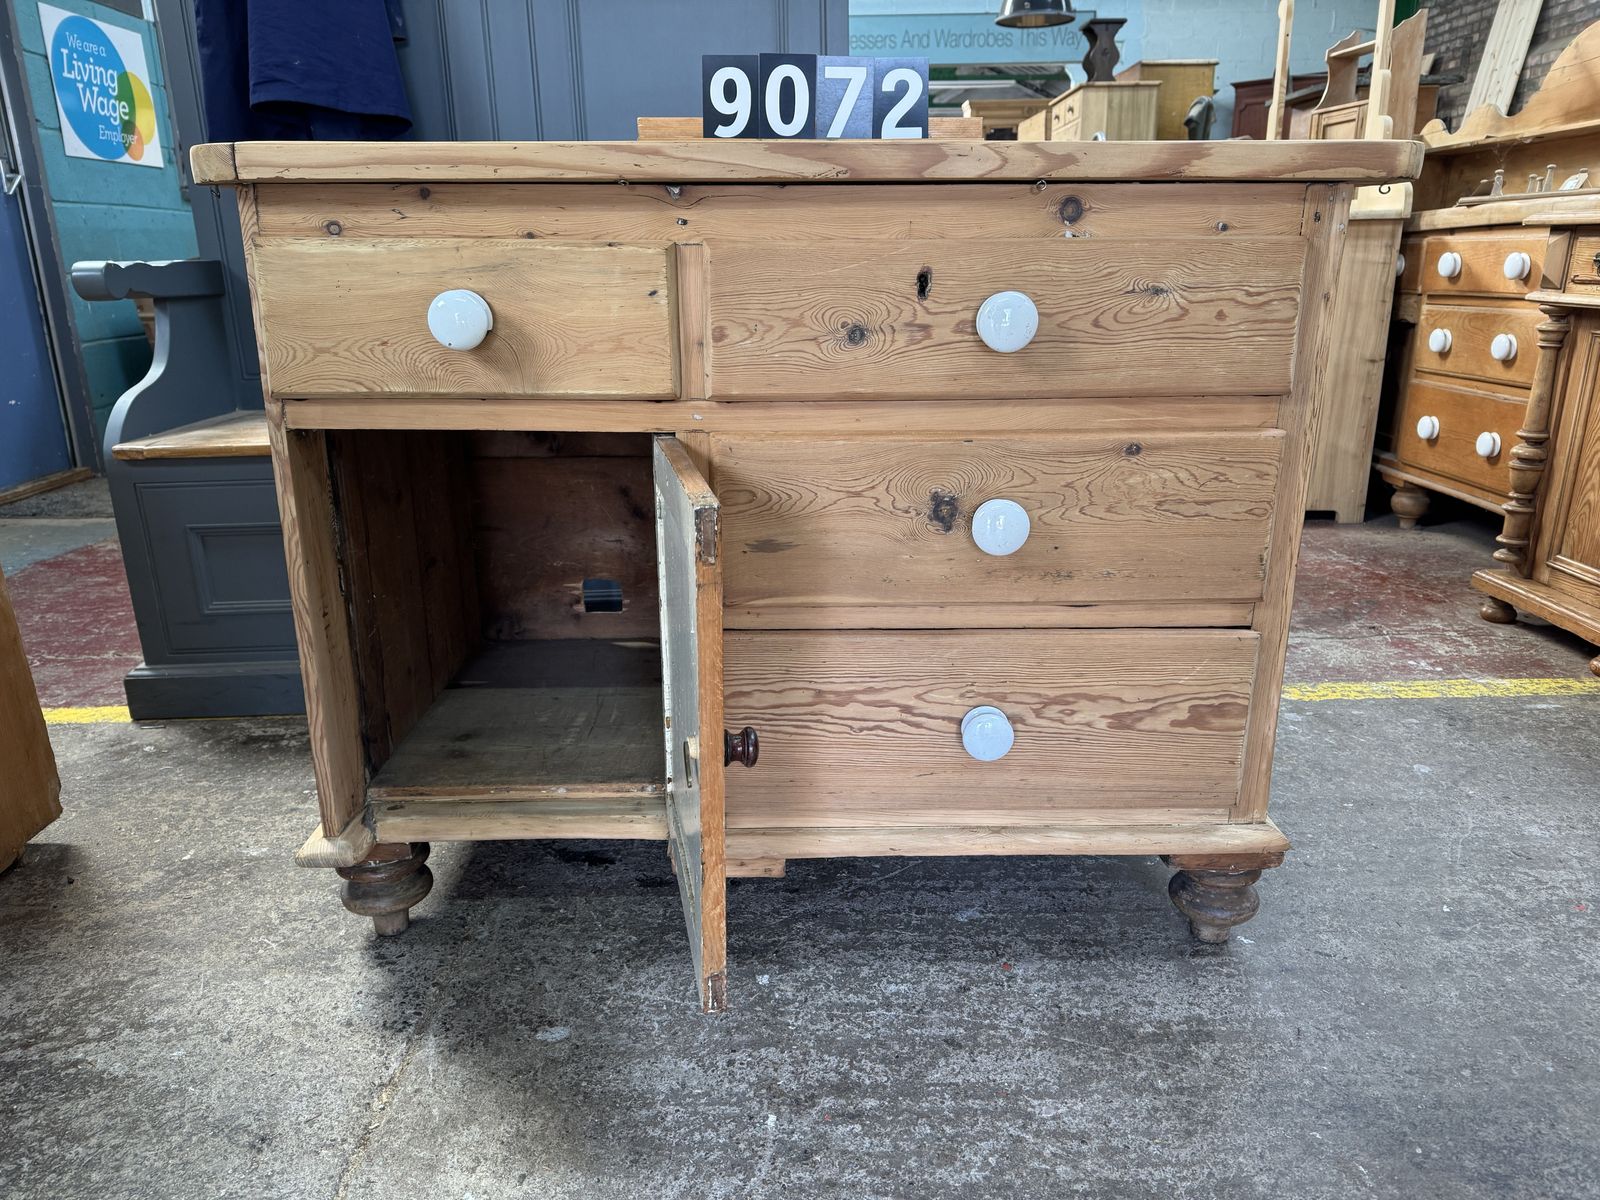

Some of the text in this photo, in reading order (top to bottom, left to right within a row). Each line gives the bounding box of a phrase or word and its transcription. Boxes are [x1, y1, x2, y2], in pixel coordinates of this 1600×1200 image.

[66, 32, 107, 57] We are a
[902, 29, 931, 48] And
[934, 28, 1014, 49] Wardrobes
[1019, 26, 1047, 47] This
[1052, 25, 1083, 51] Way
[60, 48, 117, 96] Living
[76, 83, 129, 125] Wage
[709, 64, 924, 139] 9072
[99, 125, 138, 146] Employer
